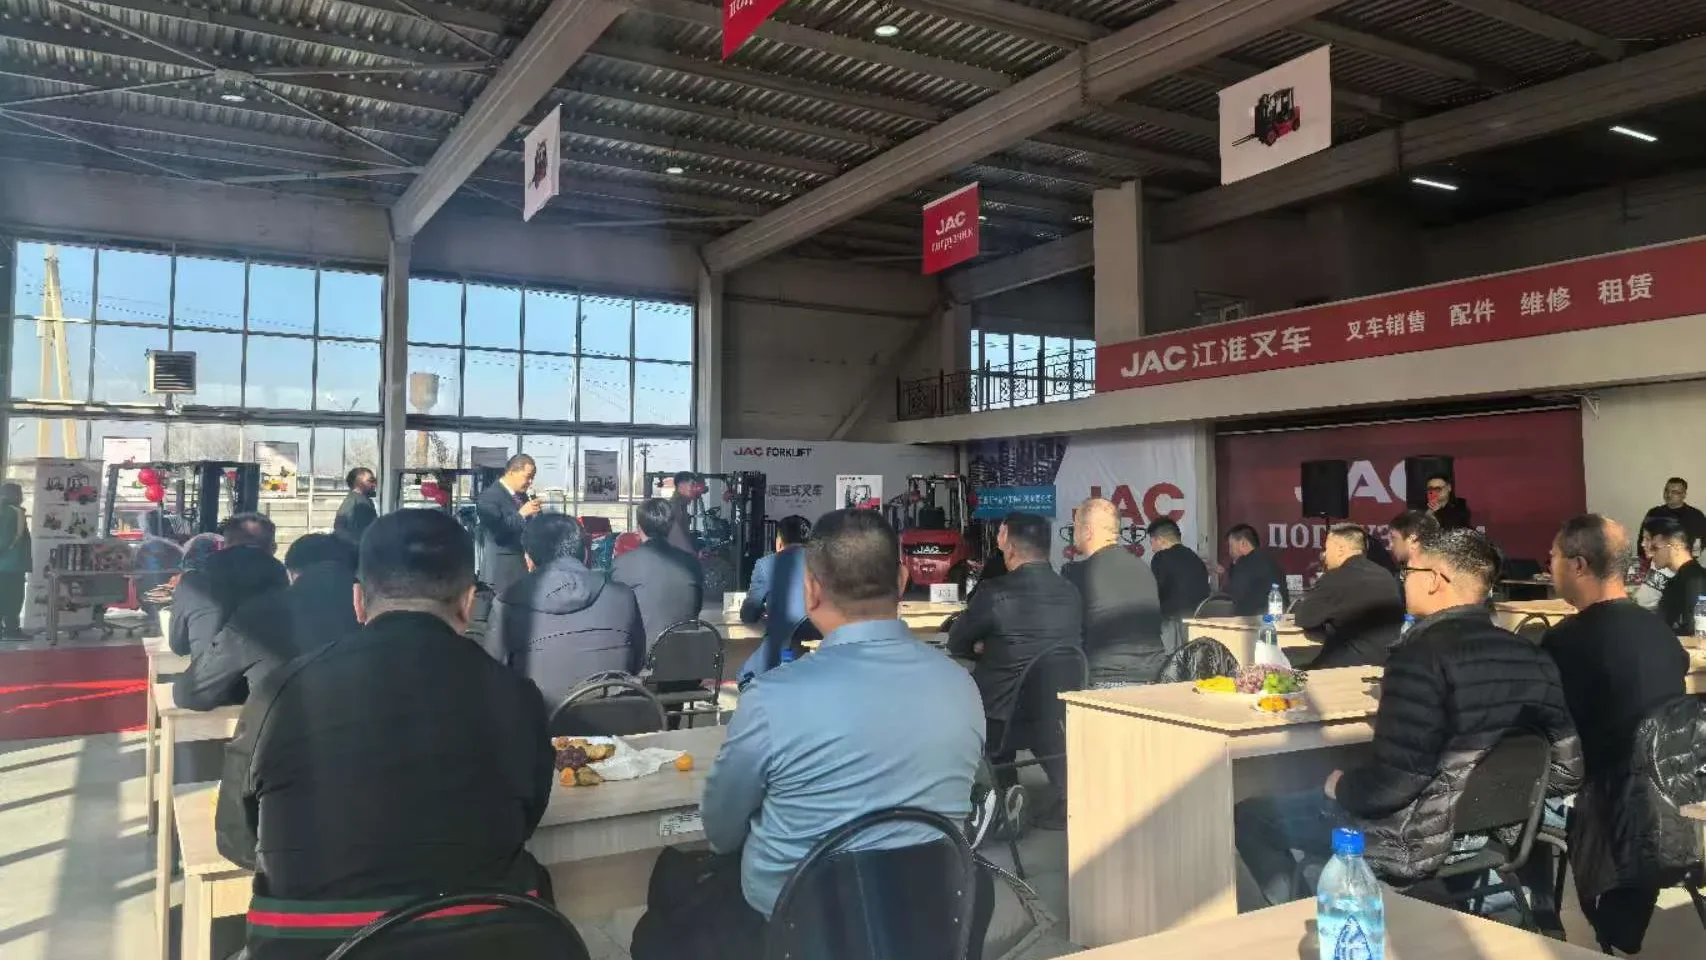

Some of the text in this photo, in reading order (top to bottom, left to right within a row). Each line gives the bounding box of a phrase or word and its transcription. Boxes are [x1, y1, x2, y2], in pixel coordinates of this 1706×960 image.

[935, 211, 967, 236] JAC
[1345, 273, 1653, 342] 叉车销售 配件 维修 租赁
[1120, 326, 1312, 378] JAC 江淮叉车
[733, 447, 813, 457] JAC FORKLIFT
[1072, 482, 1185, 526] AC
[917, 545, 940, 554] JAC
